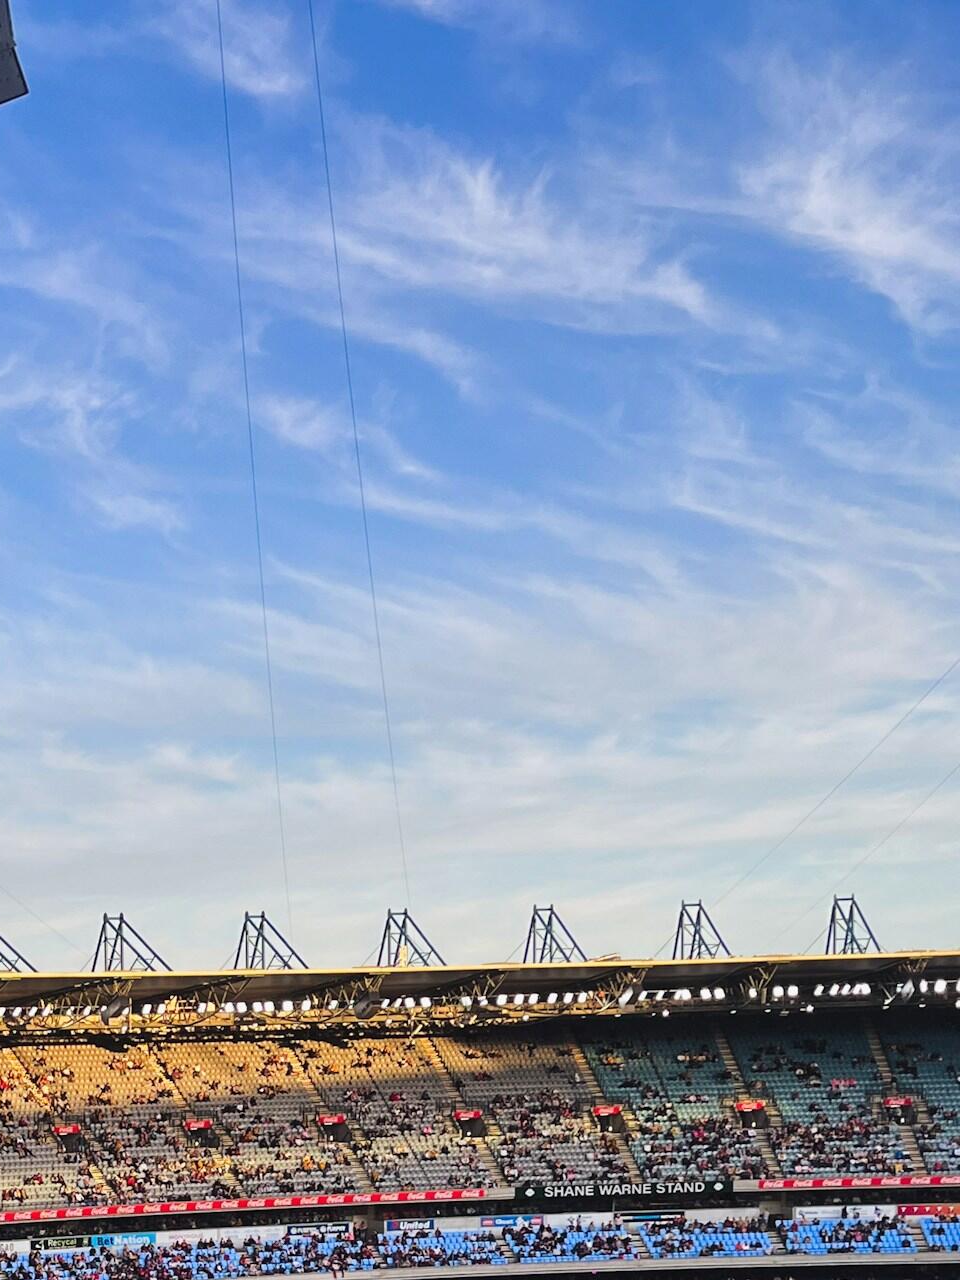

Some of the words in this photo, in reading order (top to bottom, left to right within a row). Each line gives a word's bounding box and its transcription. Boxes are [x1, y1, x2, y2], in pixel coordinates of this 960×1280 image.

[544, 1185, 594, 1197] SHANE
[599, 1183, 651, 1196] WARNE
[656, 1182, 705, 1194] STAND
[399, 1221, 430, 1230] United
[47, 1239, 77, 1247] Recycal
[97, 1236, 150, 1247] BetNation
